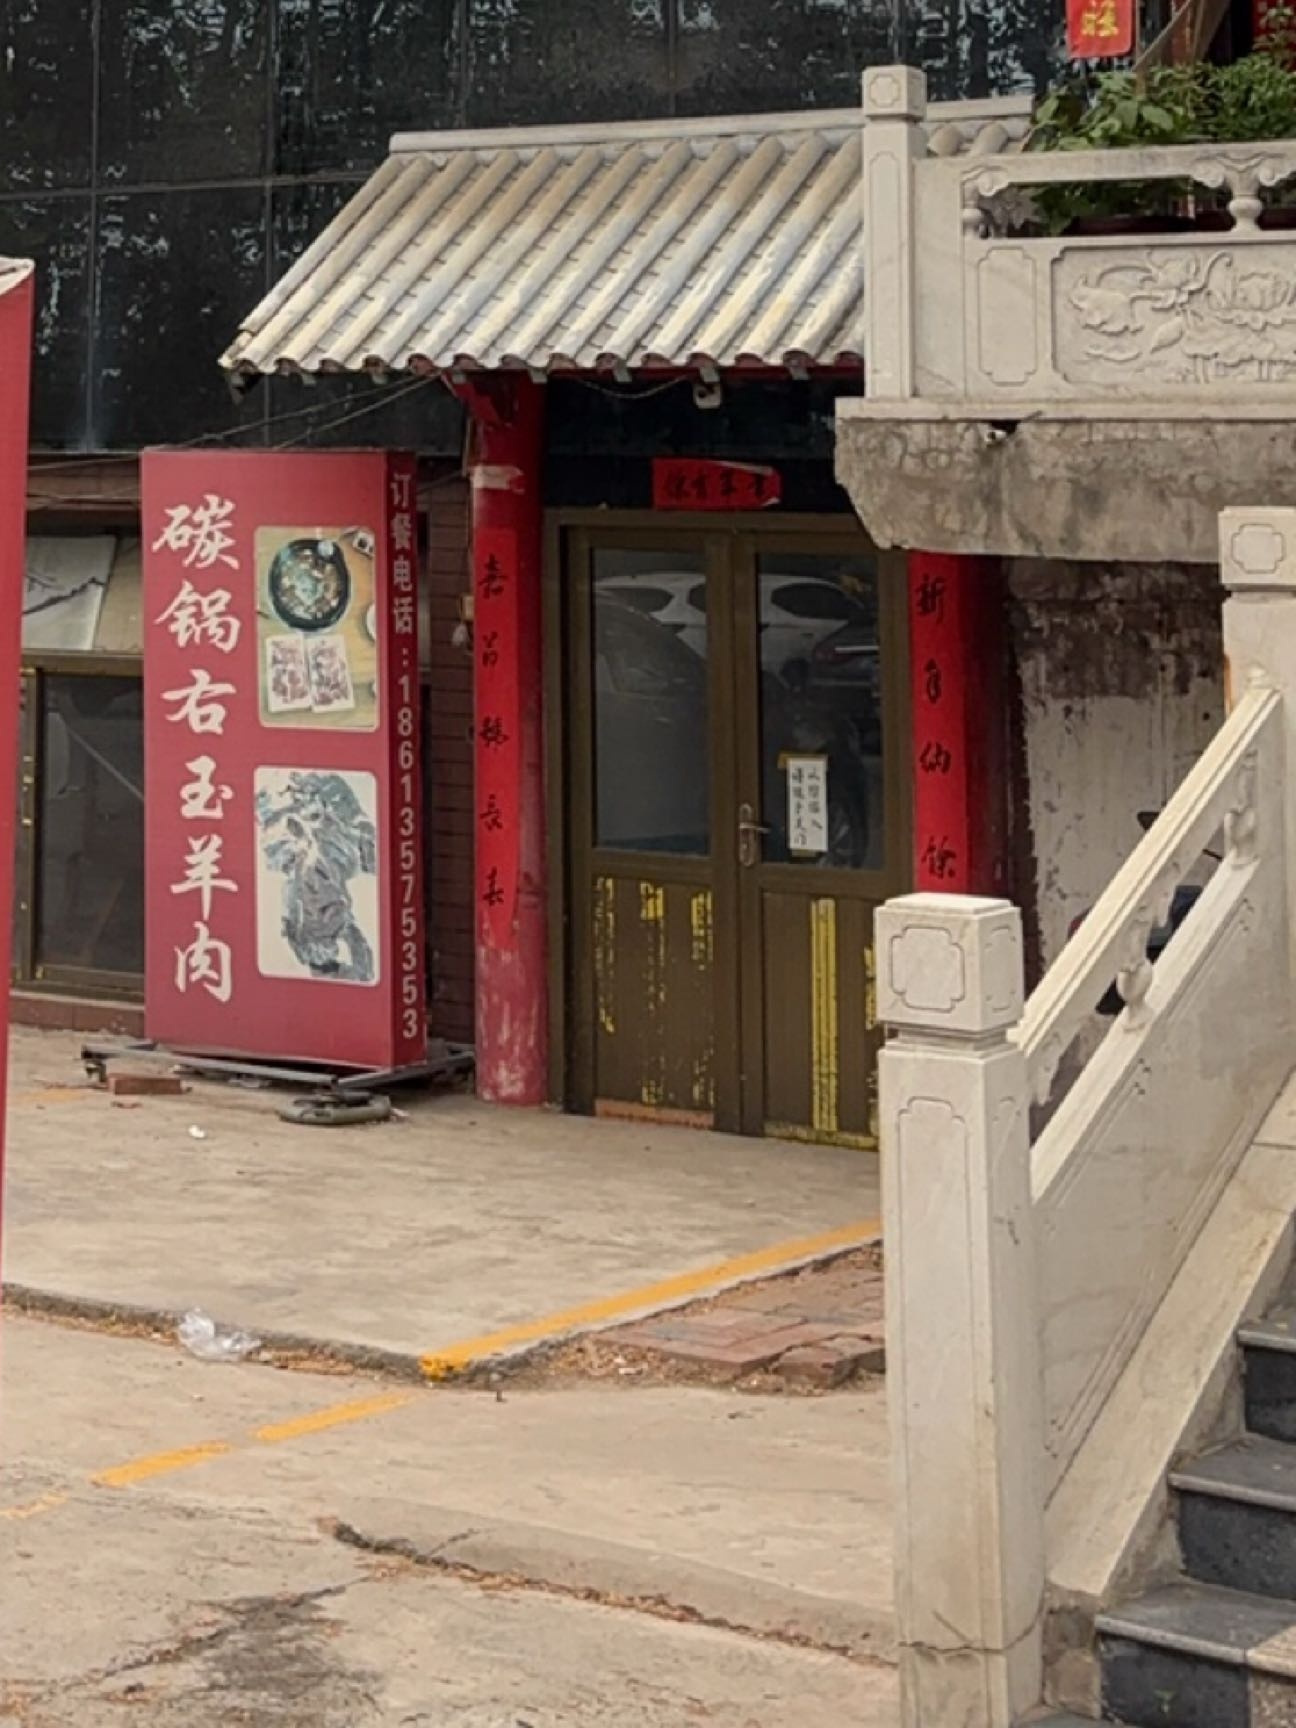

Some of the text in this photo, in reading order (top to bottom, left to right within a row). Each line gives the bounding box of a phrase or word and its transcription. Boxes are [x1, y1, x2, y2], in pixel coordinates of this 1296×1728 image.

[152, 493, 242, 1005] 碳锅右玉羊肉
